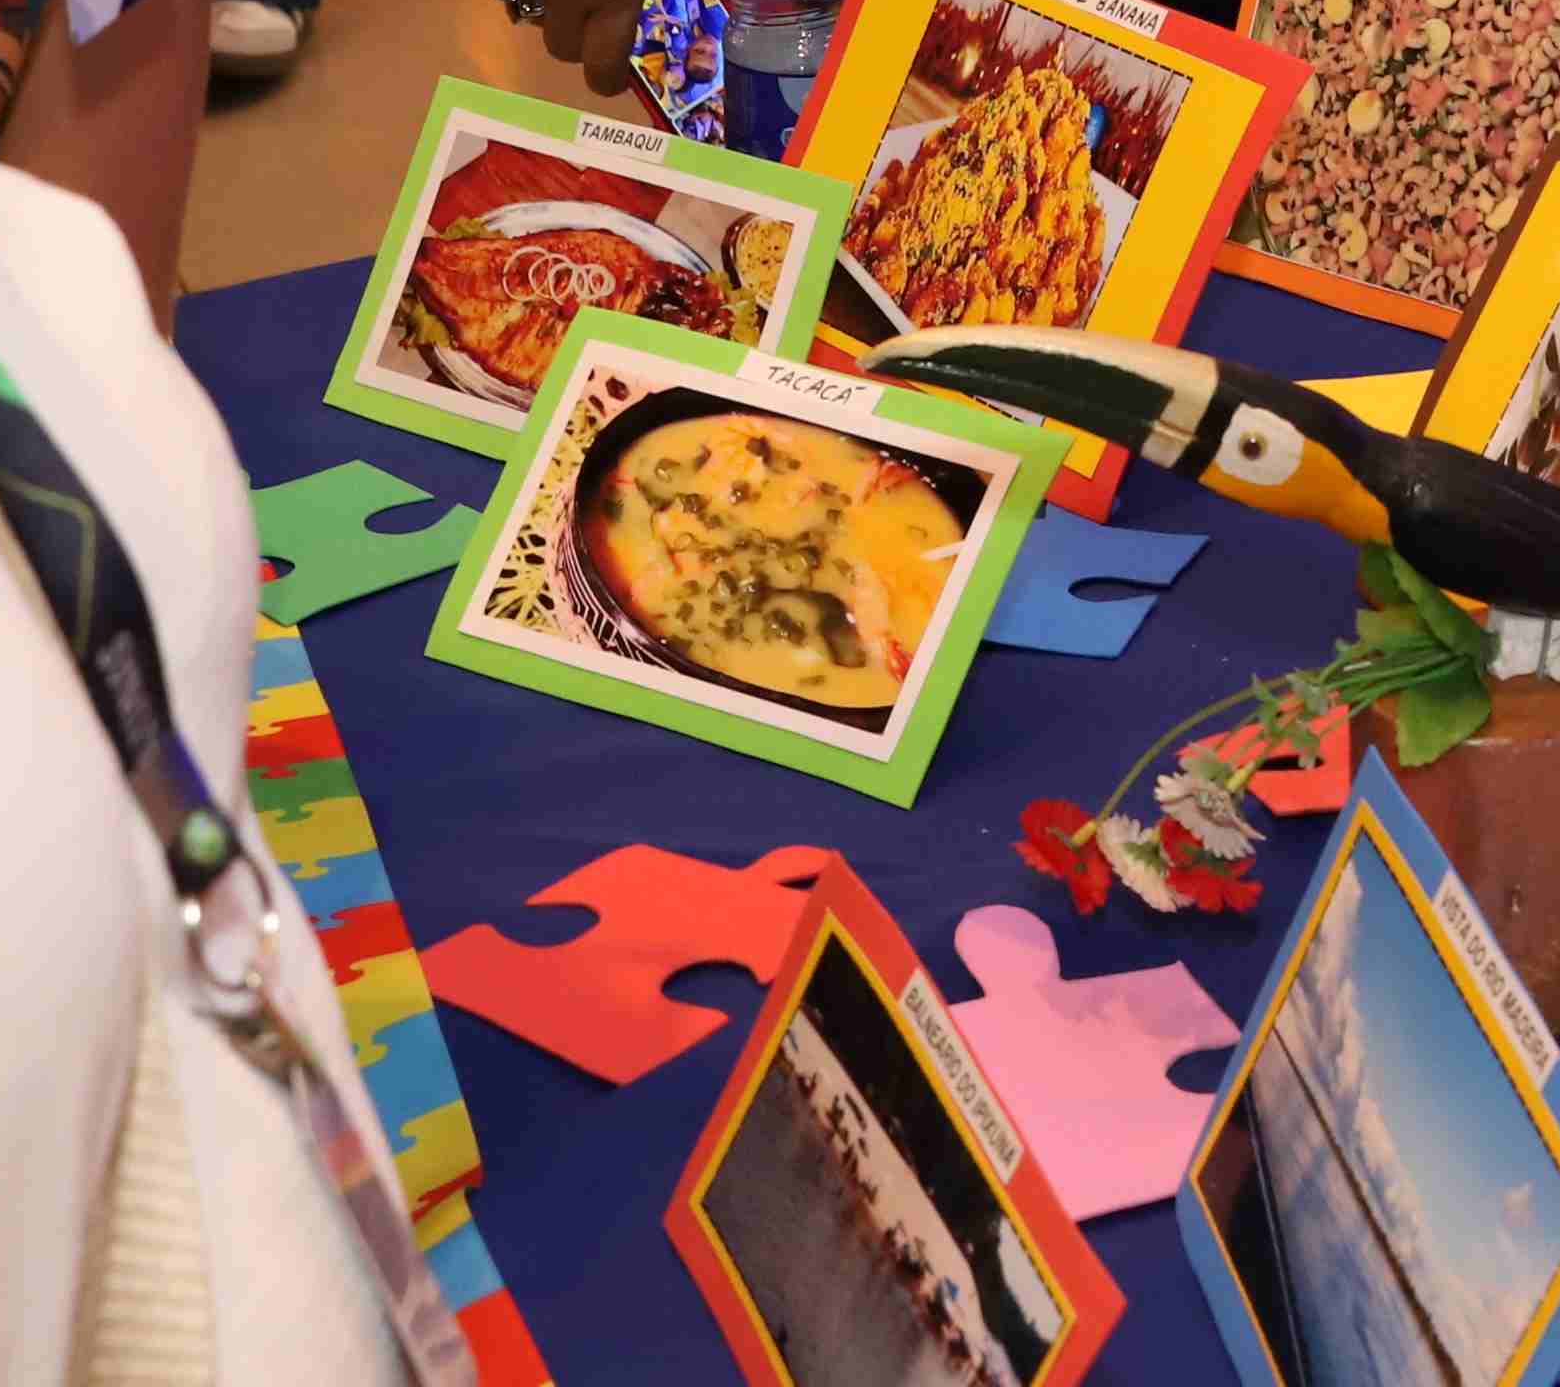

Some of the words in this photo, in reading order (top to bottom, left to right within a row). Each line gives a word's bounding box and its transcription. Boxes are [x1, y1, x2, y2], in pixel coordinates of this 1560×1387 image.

[580, 121, 664, 152] TAMBAQUI
[1466, 934, 1487, 967] DO
[1482, 960, 1507, 997] RIO
